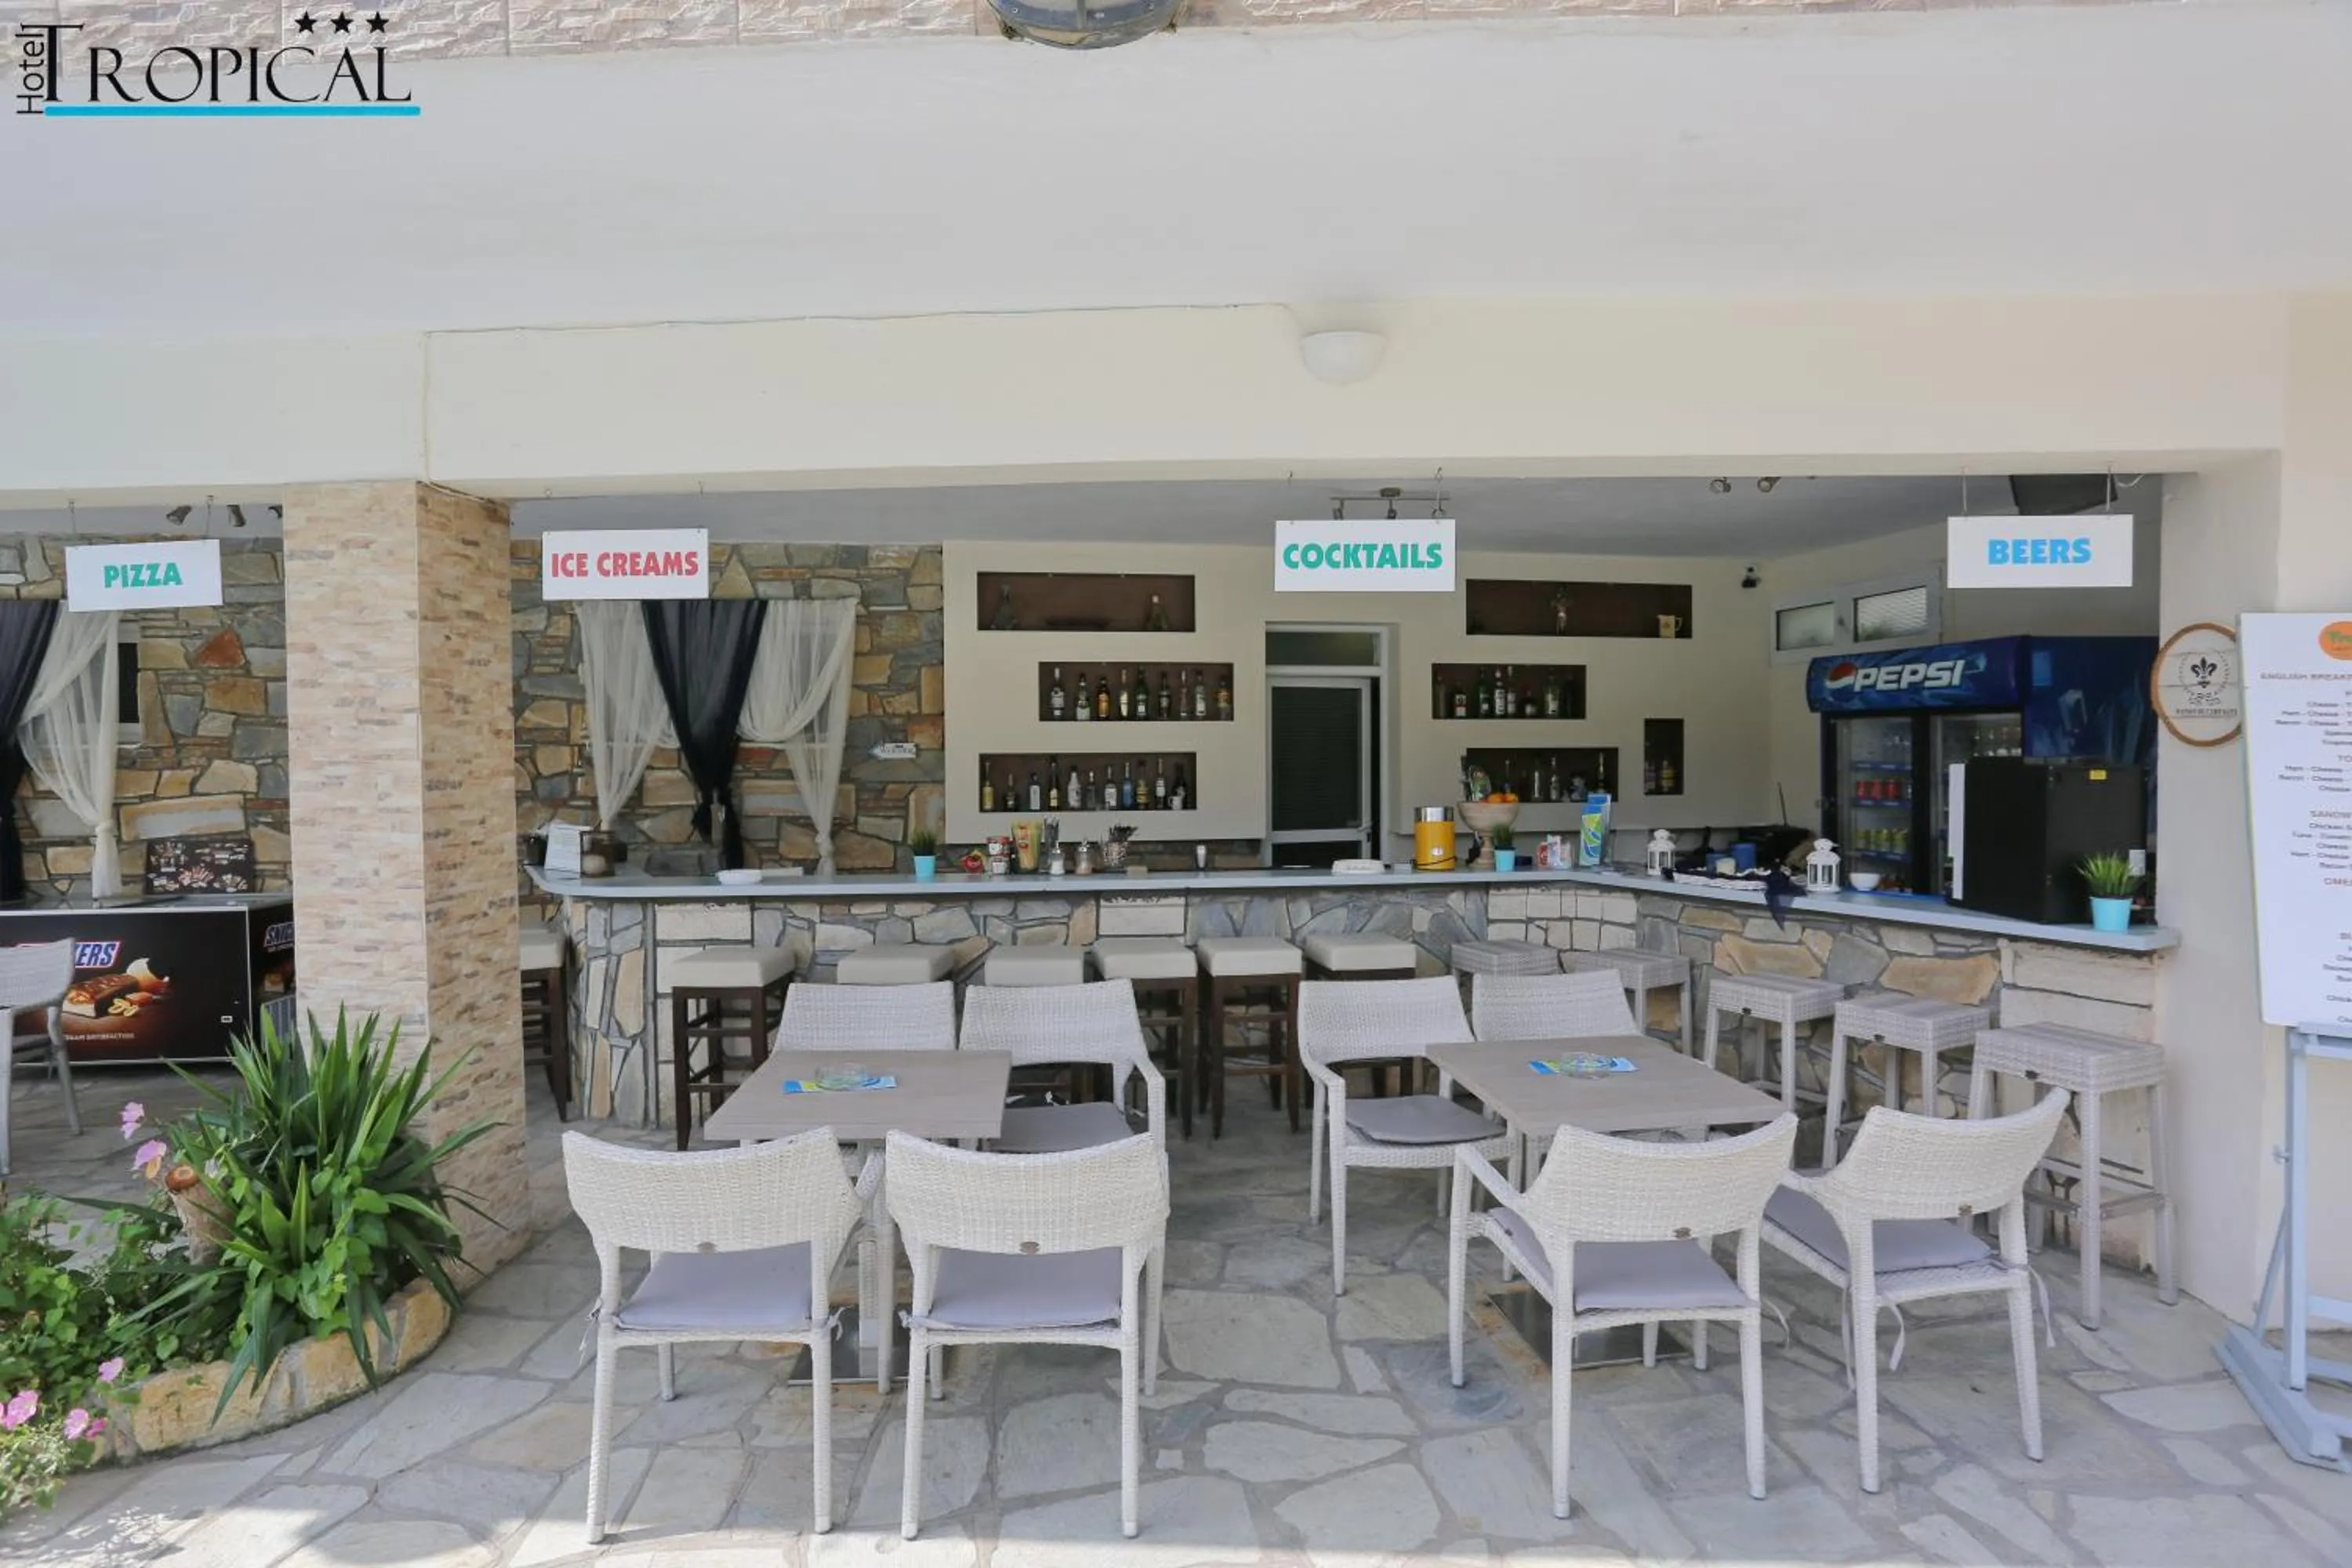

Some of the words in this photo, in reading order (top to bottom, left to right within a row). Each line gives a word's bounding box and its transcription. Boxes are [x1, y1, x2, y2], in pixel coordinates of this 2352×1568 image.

[551, 553, 589, 578] ICE
[597, 551, 699, 577] CREAMS
[1283, 542, 1443, 569] COCKTAILS
[1987, 537, 2092, 565] BEERS
[103, 562, 183, 588] PIZZA
[1853, 659, 1966, 692] PEPSI
